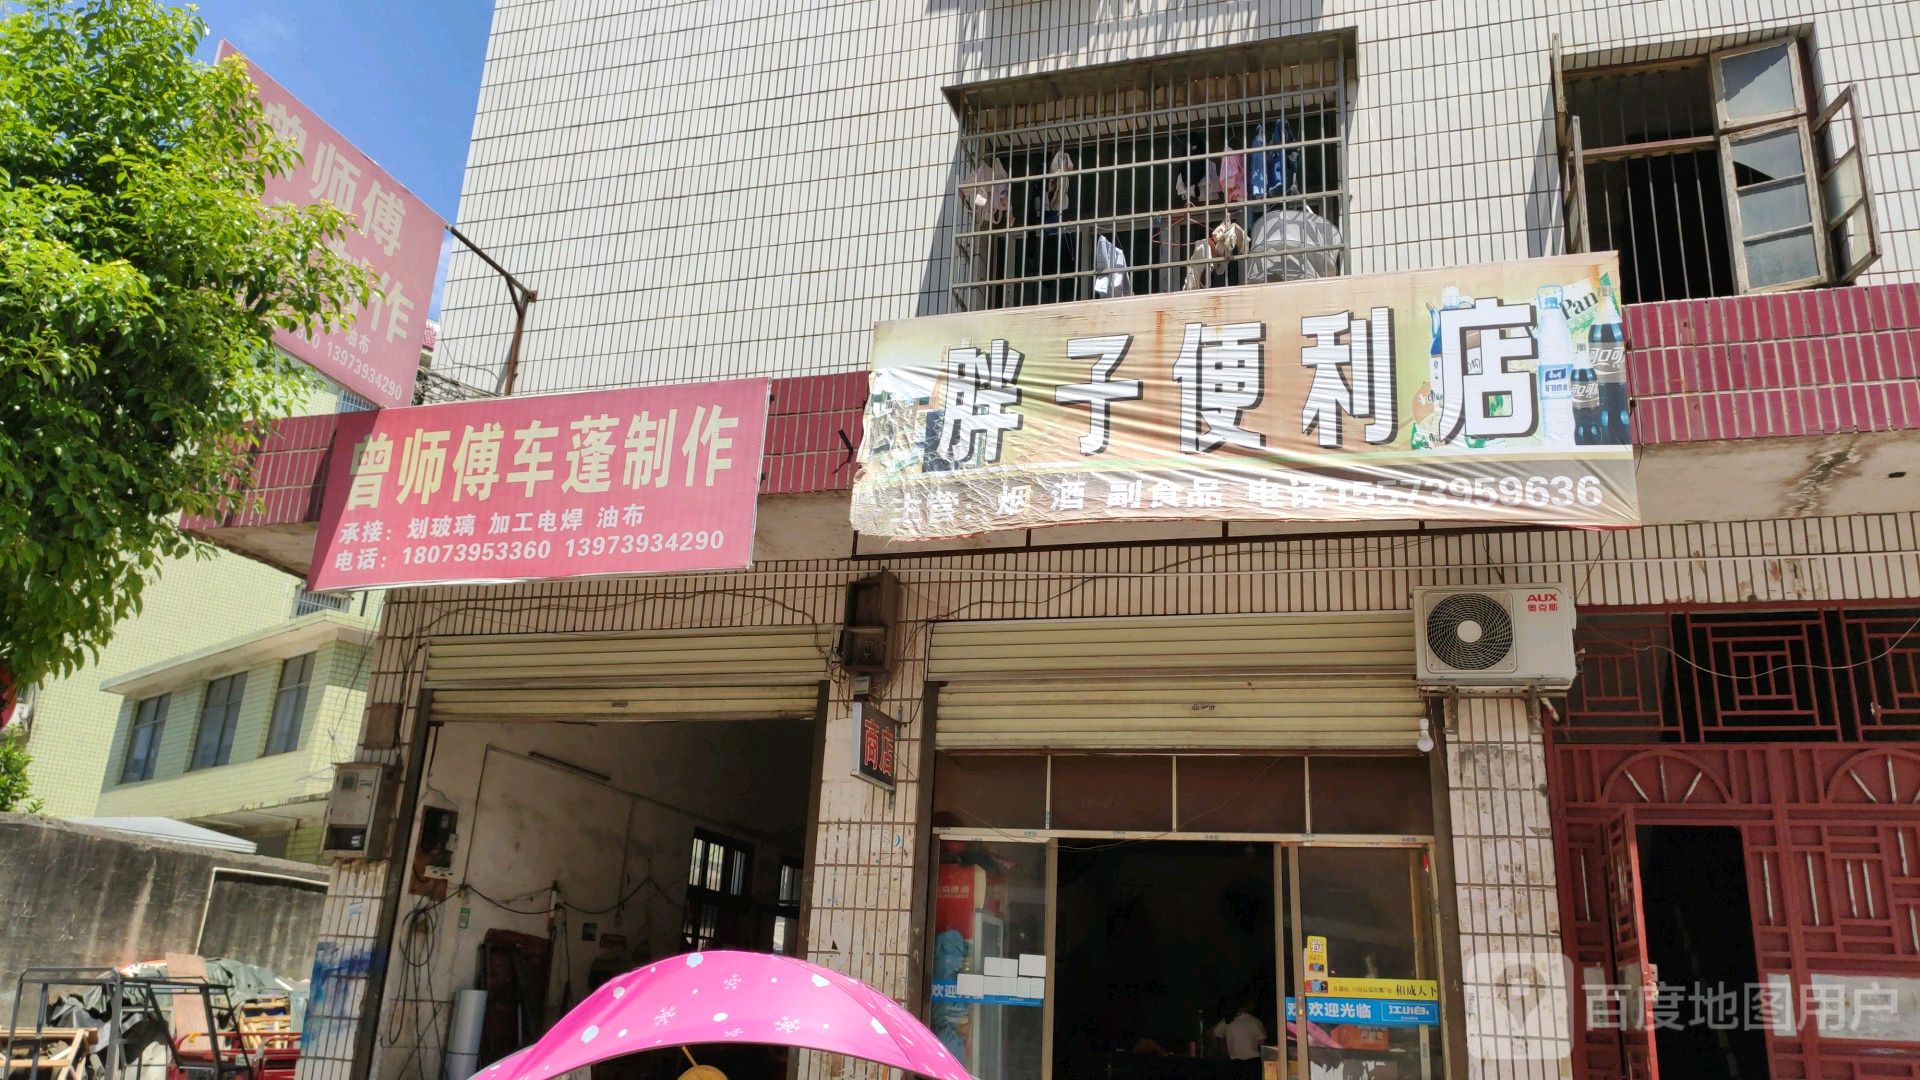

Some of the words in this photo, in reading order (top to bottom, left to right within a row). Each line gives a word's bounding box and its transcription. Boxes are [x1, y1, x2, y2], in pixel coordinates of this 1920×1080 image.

[1560, 291, 1599, 320] Pan
[327, 341, 402, 400] 13973934290
[937, 297, 1538, 463] 胖子便利店
[347, 404, 739, 511] 曾师傅车蓬制作
[1050, 479, 1086, 511] 酒
[1106, 479, 1223, 511] 副食品
[407, 514, 474, 539] 划玻璃
[488, 507, 583, 535] 加工电焊
[597, 503, 645, 528] 油布
[402, 539, 551, 565] 18073953360
[565, 530, 725, 558] 13973934290
[1527, 593, 1558, 602] AUX
[1527, 603, 1559, 612] 奥克斯
[864, 718, 894, 777] 商店
[1308, 1001, 1373, 1020] 欢迎光临
